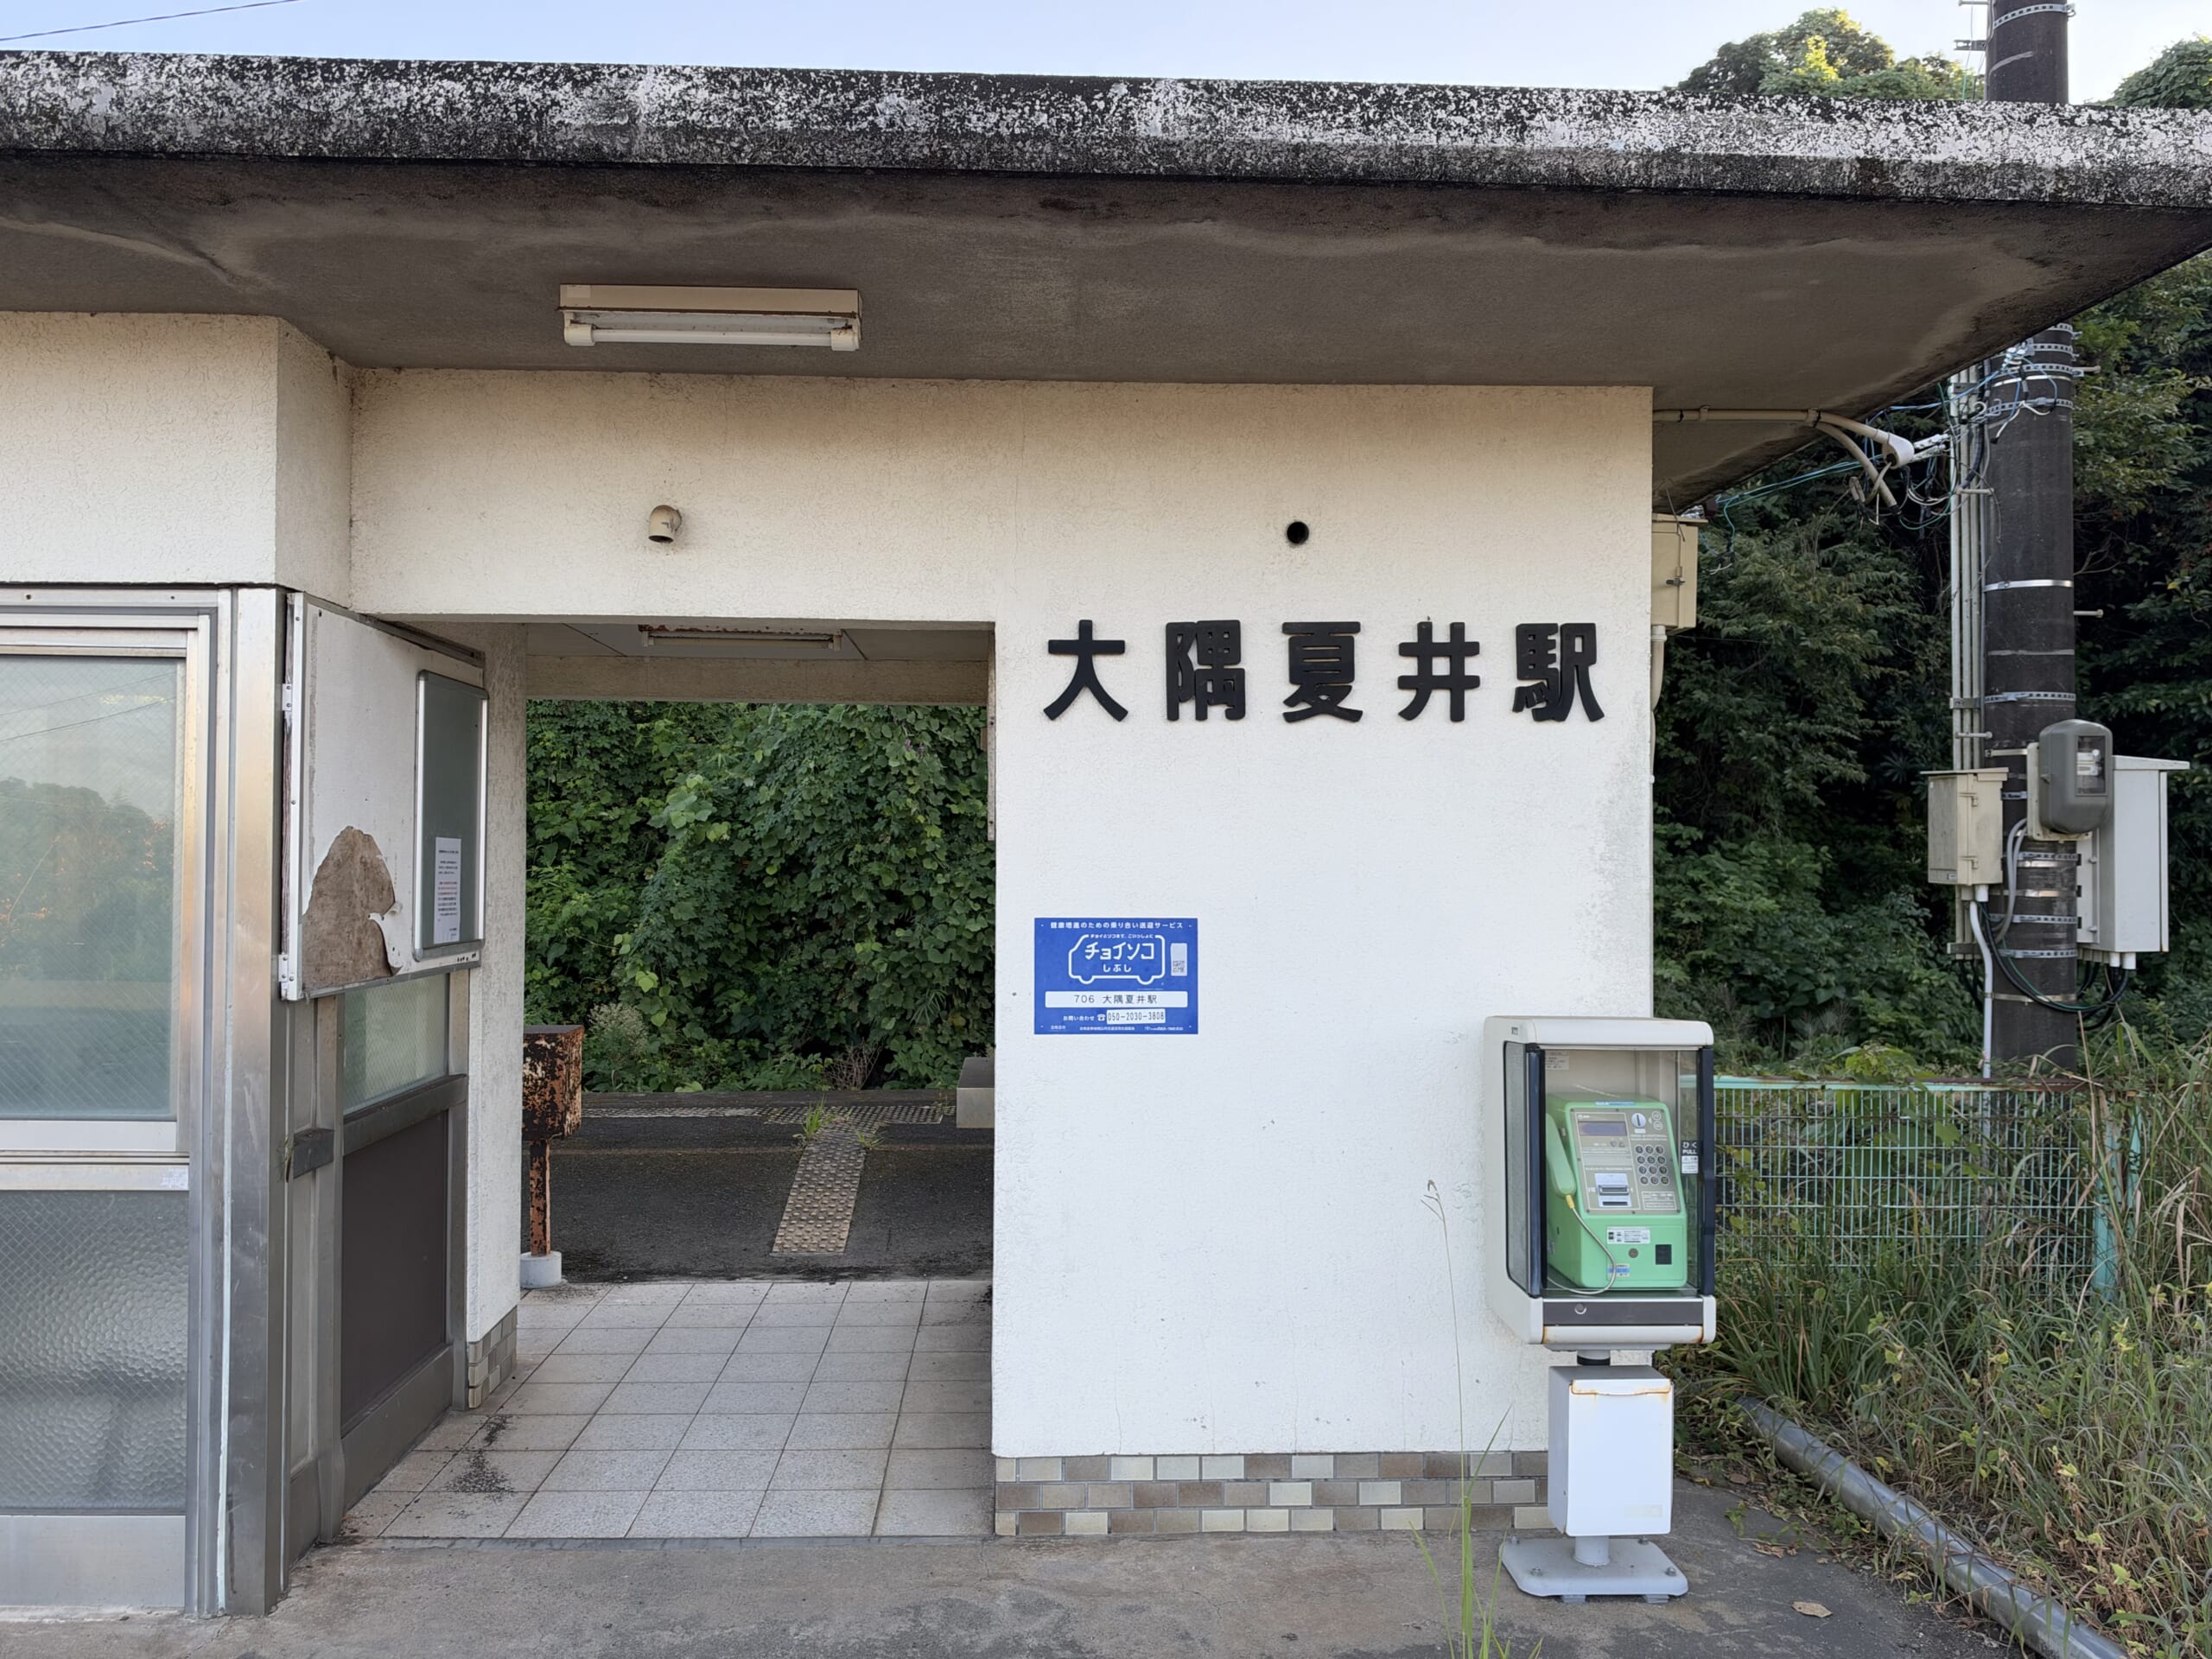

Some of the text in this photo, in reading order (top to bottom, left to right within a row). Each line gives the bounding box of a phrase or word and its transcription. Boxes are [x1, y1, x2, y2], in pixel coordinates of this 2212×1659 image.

[1043, 619, 1605, 722] 大隅夏井駅
[1084, 941, 1155, 961] チョイソコ
[1103, 963, 1132, 973] しぶし
[1073, 994, 1158, 1004] 706 大隅夏井駅
